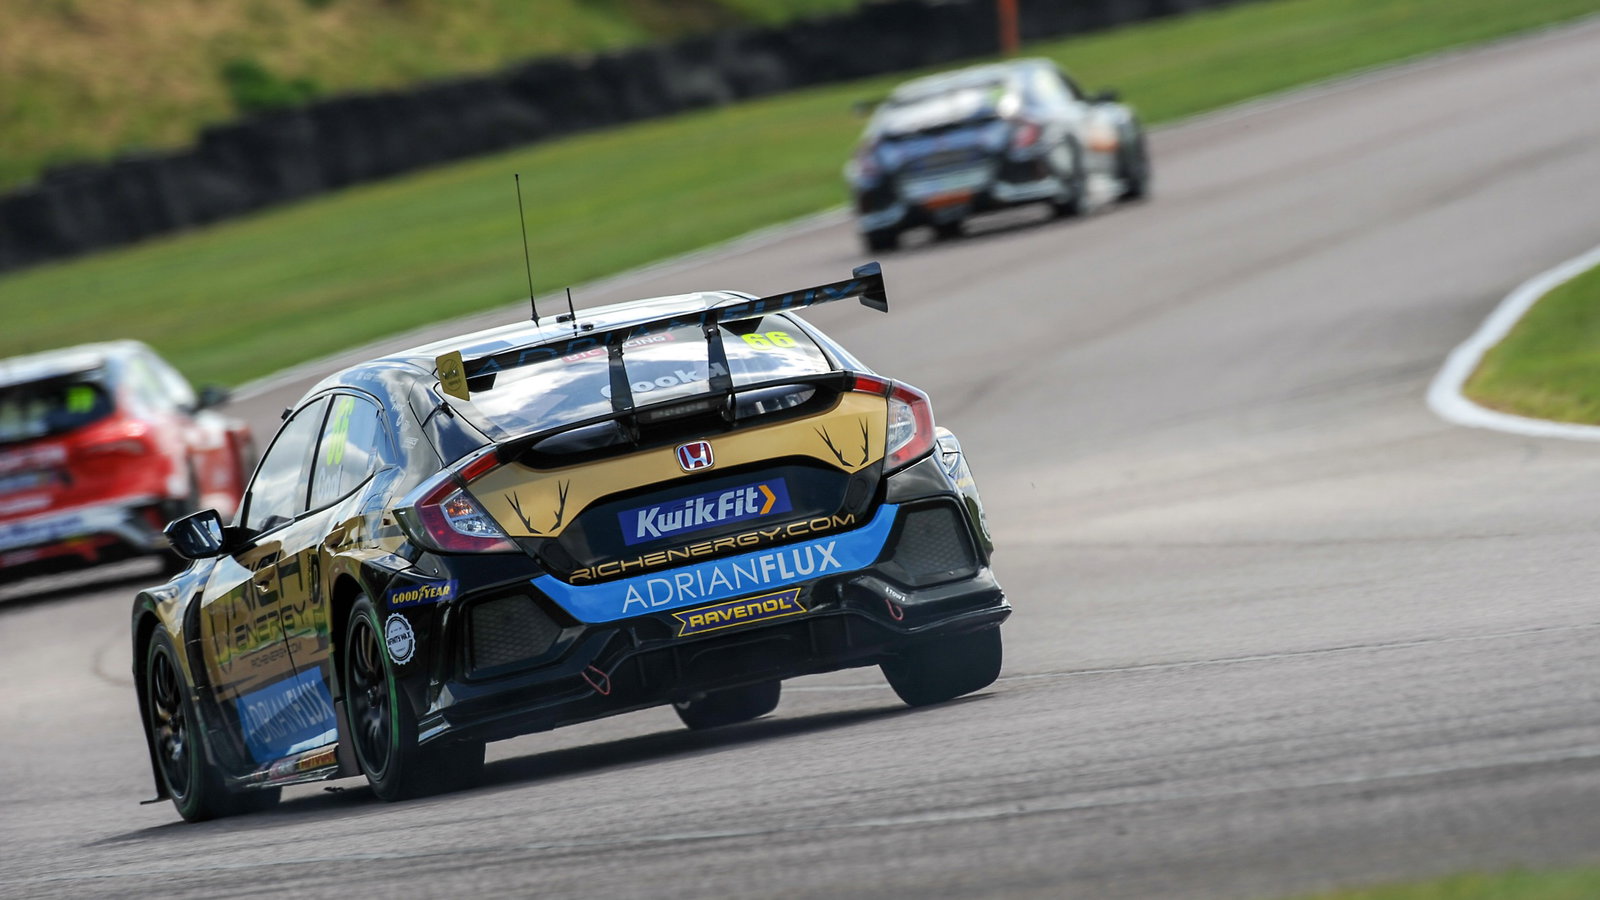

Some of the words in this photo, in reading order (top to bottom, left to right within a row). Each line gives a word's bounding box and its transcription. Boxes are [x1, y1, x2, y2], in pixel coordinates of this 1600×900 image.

[741, 331, 797, 351] 66
[569, 513, 856, 584] RICHENERGY.COM
[235, 600, 306, 651] ENERGY
[688, 597, 793, 629] RAVENOL
